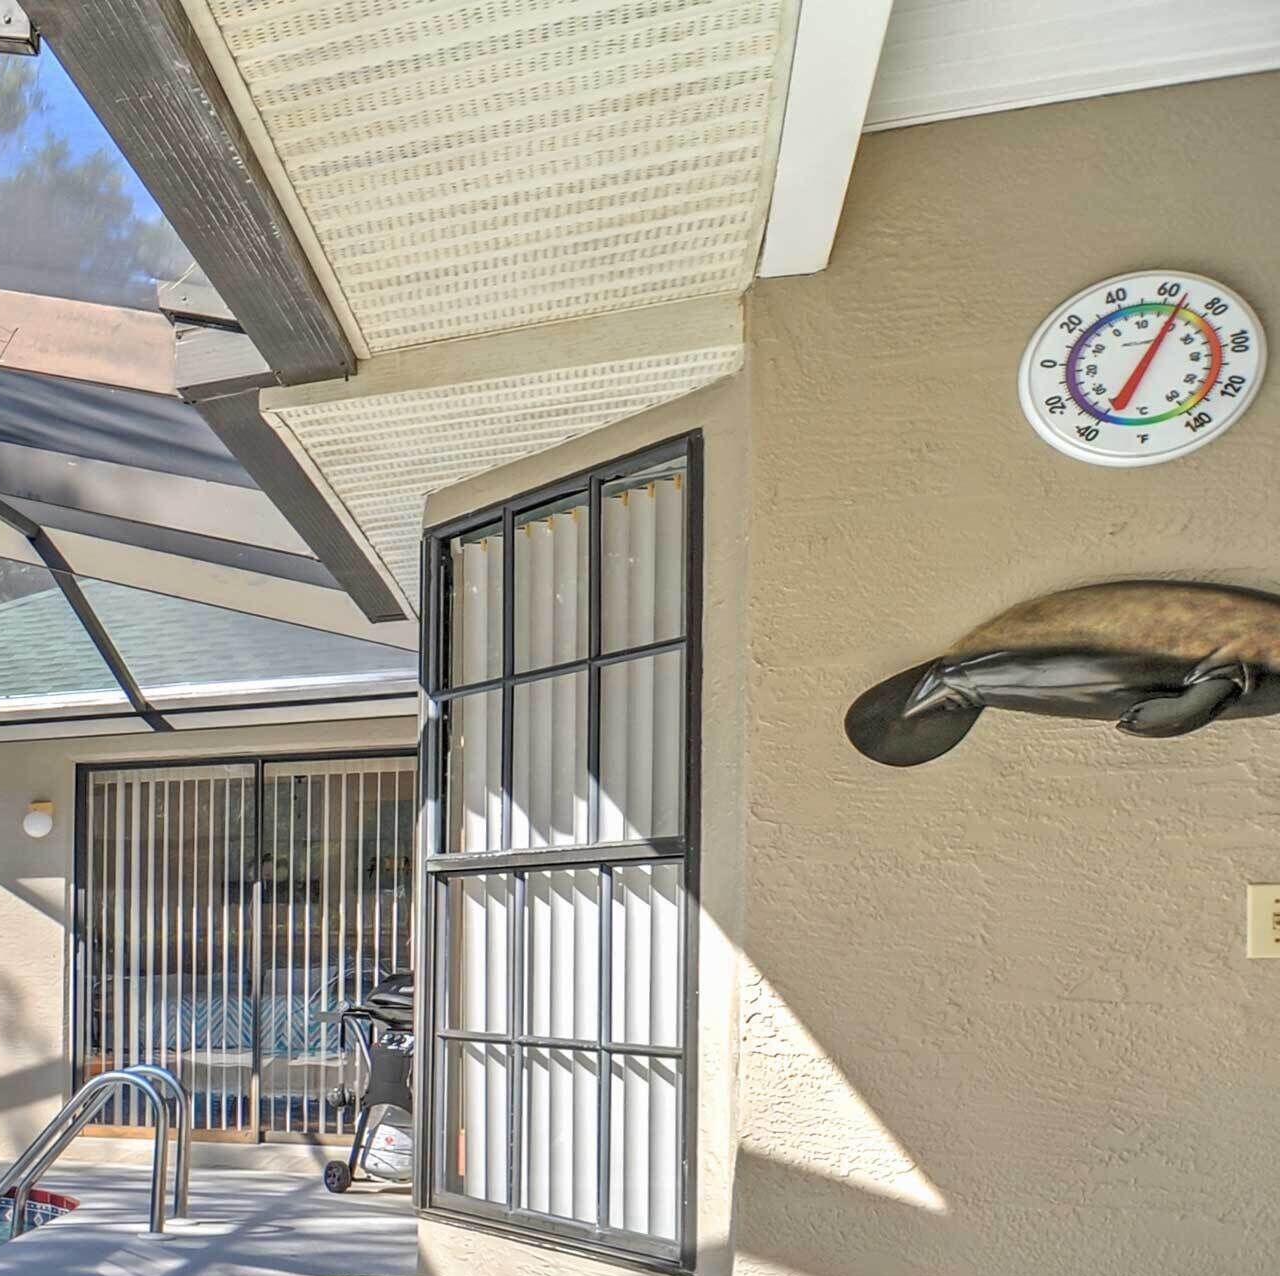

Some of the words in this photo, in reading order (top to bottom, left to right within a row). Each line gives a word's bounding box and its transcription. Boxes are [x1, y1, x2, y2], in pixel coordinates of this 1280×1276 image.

[1105, 288, 1127, 305] 40
[1157, 282, 1180, 297] 60
[1204, 298, 1228, 316] 80
[1060, 314, 1082, 334] 20
[1135, 319, 1148, 329] 10
[1230, 330, 1249, 353] 100
[1040, 360, 1058, 368] 0
[1221, 375, 1245, 398] 120
[1166, 390, 1180, 403] 60
[1185, 412, 1212, 433] 140
[1076, 425, 1099, 442] -40
